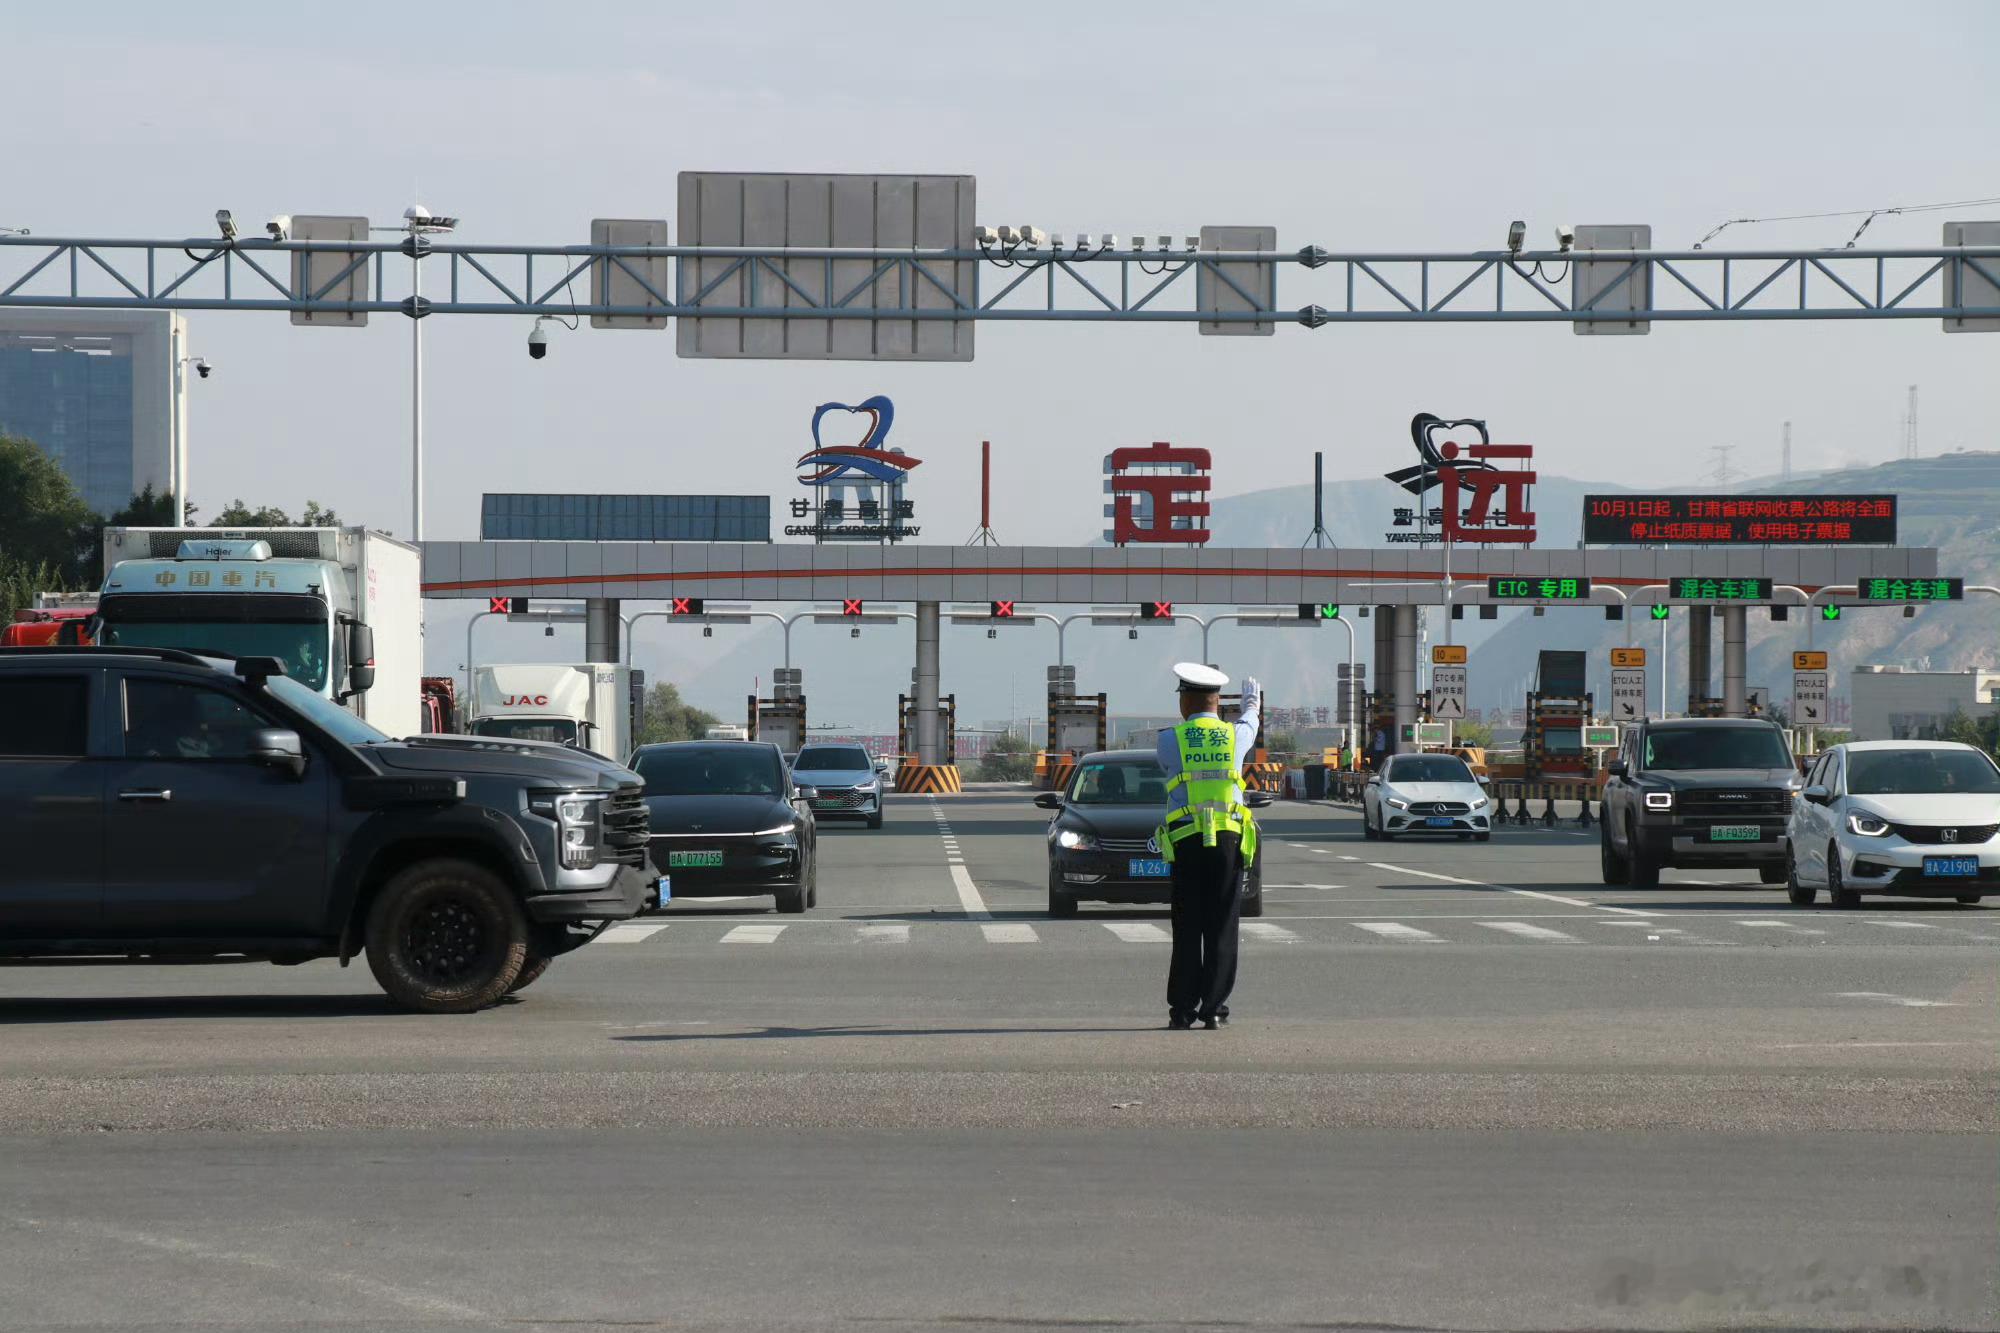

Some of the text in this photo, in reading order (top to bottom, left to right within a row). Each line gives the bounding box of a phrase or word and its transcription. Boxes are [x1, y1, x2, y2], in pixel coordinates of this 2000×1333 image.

[1437, 441, 1537, 543] 远
[206, 548, 233, 556] Haier
[155, 570, 276, 588] 中国重汽
[1497, 579, 1578, 598] ETC 专用
[1679, 579, 1760, 599] 混合车道
[1868, 580, 1950, 600] 混合车道
[1436, 650, 1446, 660] 10
[1617, 653, 1627, 662] 5
[1799, 655, 1808, 665] 5
[502, 695, 548, 706] JAC
[1184, 727, 1230, 748] 警察
[1185, 752, 1231, 763] POLICE
